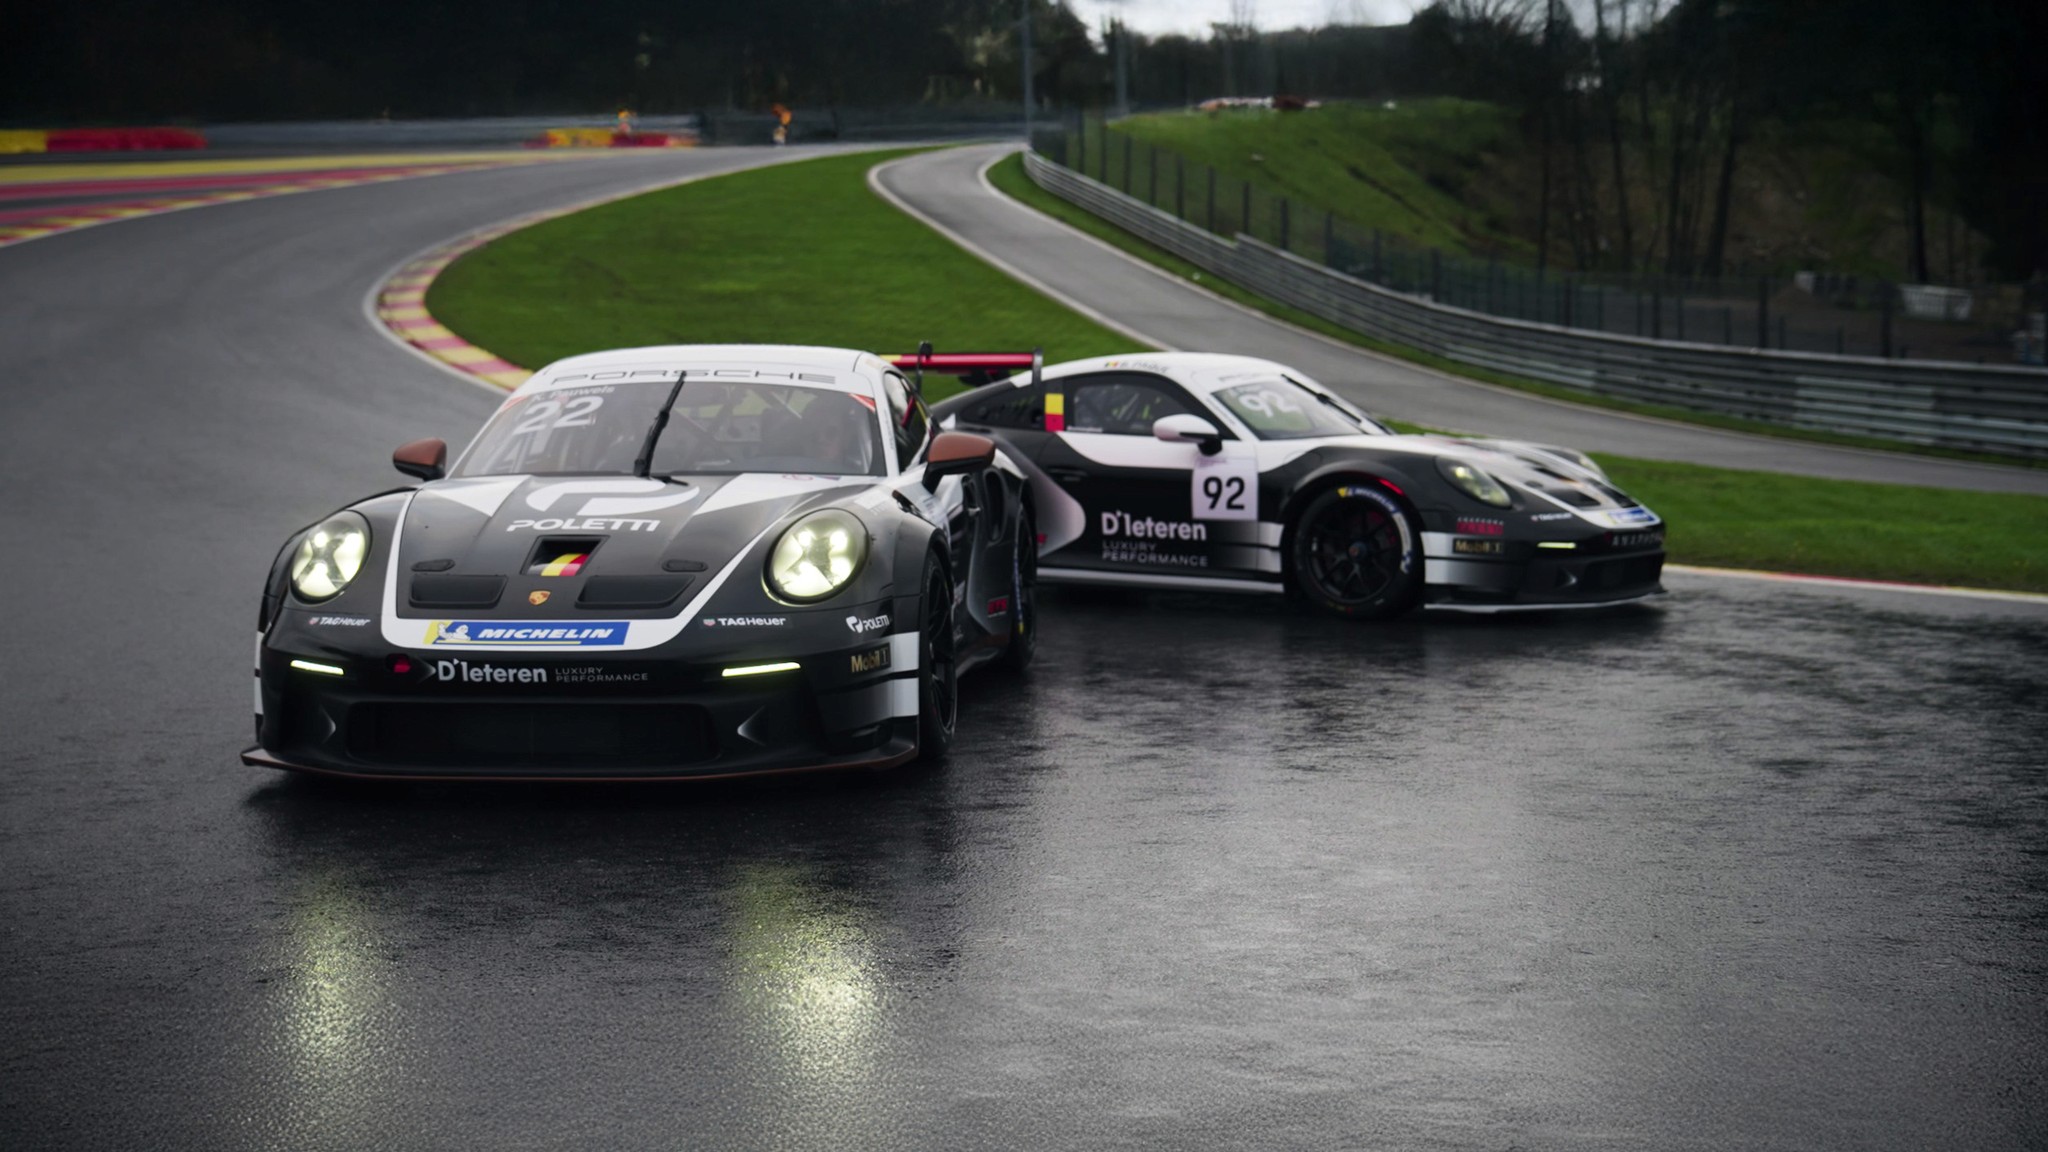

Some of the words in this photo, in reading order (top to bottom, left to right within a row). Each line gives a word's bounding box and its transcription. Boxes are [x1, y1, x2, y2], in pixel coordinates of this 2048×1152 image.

[551, 370, 836, 385] PORSCHE
[1238, 389, 1301, 418] 92
[512, 396, 605, 435] 22
[1202, 475, 1246, 511] 92
[506, 518, 661, 532] POLETTI
[1102, 541, 1157, 551] LUXURY
[1101, 550, 1208, 567] PERFORMANCE
[863, 614, 890, 631] POLETTI
[478, 628, 614, 639] MICHELIN
[851, 650, 881, 673] Mobil
[555, 667, 604, 675] LUXURY
[555, 673, 649, 683] PERFORMANCE
